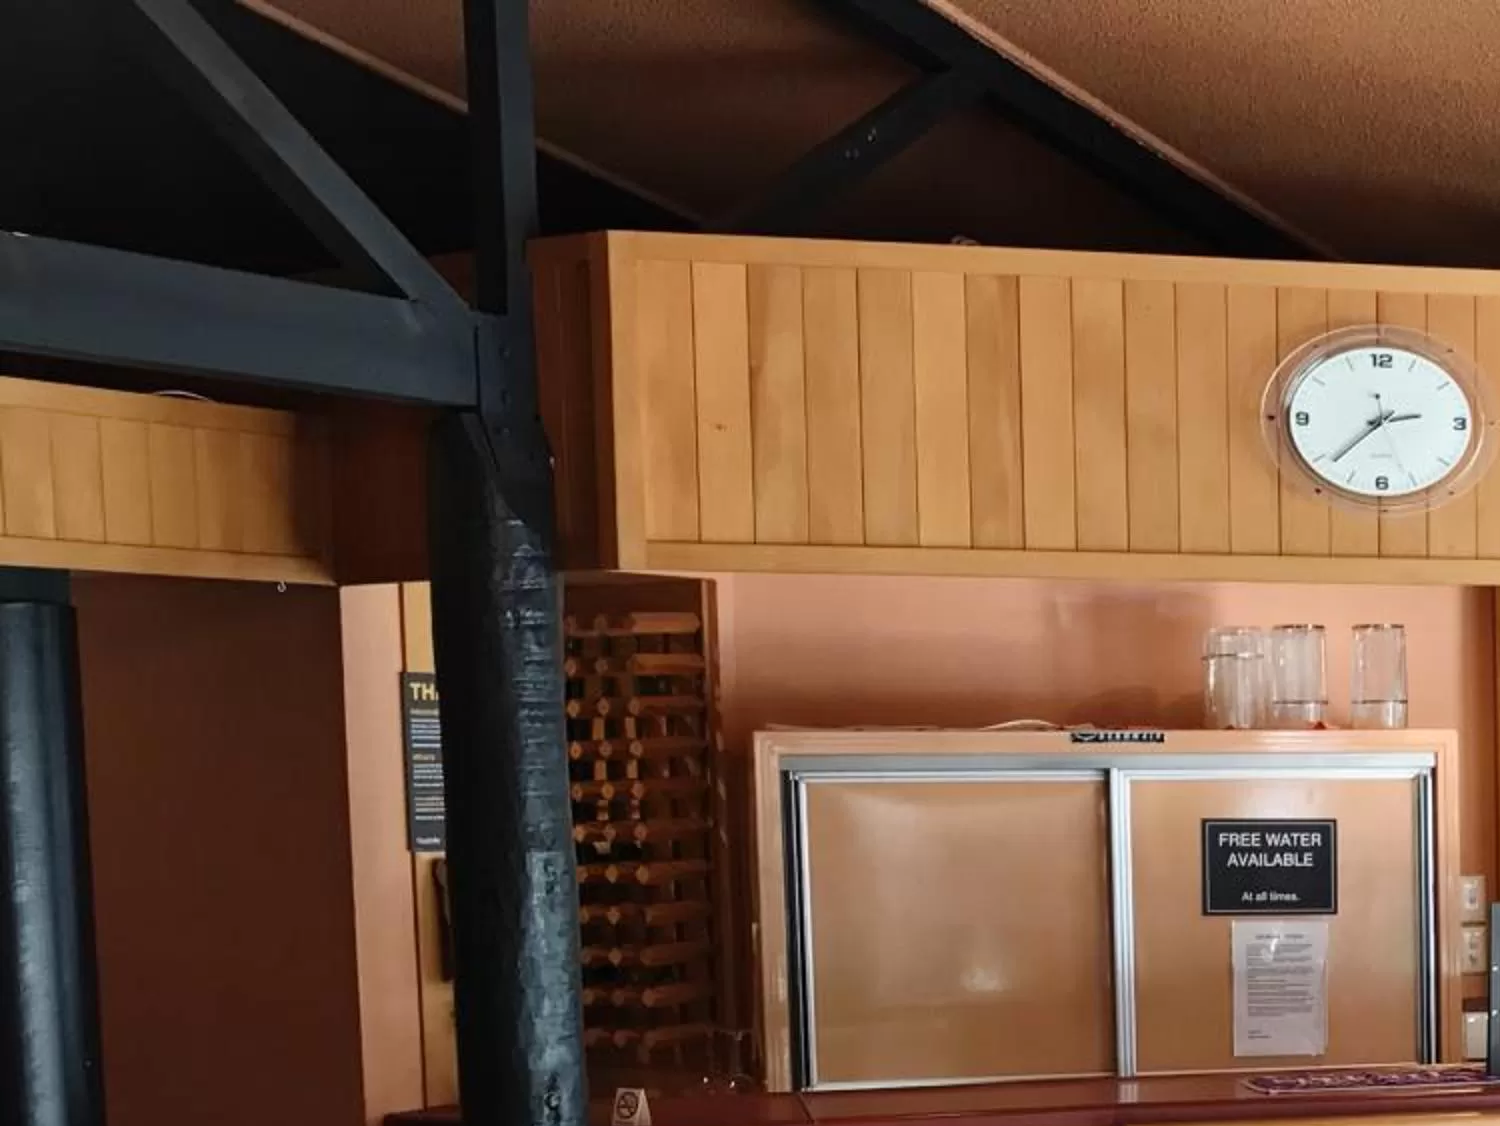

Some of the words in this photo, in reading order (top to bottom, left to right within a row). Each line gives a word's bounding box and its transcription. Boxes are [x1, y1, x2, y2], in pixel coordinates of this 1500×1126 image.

[1370, 353, 1393, 369] 12
[1296, 411, 1310, 426] 9
[1453, 417, 1467, 431] 3
[1375, 476, 1389, 490] 6
[410, 682, 440, 700] TH
[1219, 832, 1261, 847] FREE
[1265, 832, 1322, 847] WATER
[1227, 852, 1314, 867] AVAILABLE
[1241, 891, 1253, 902] At
